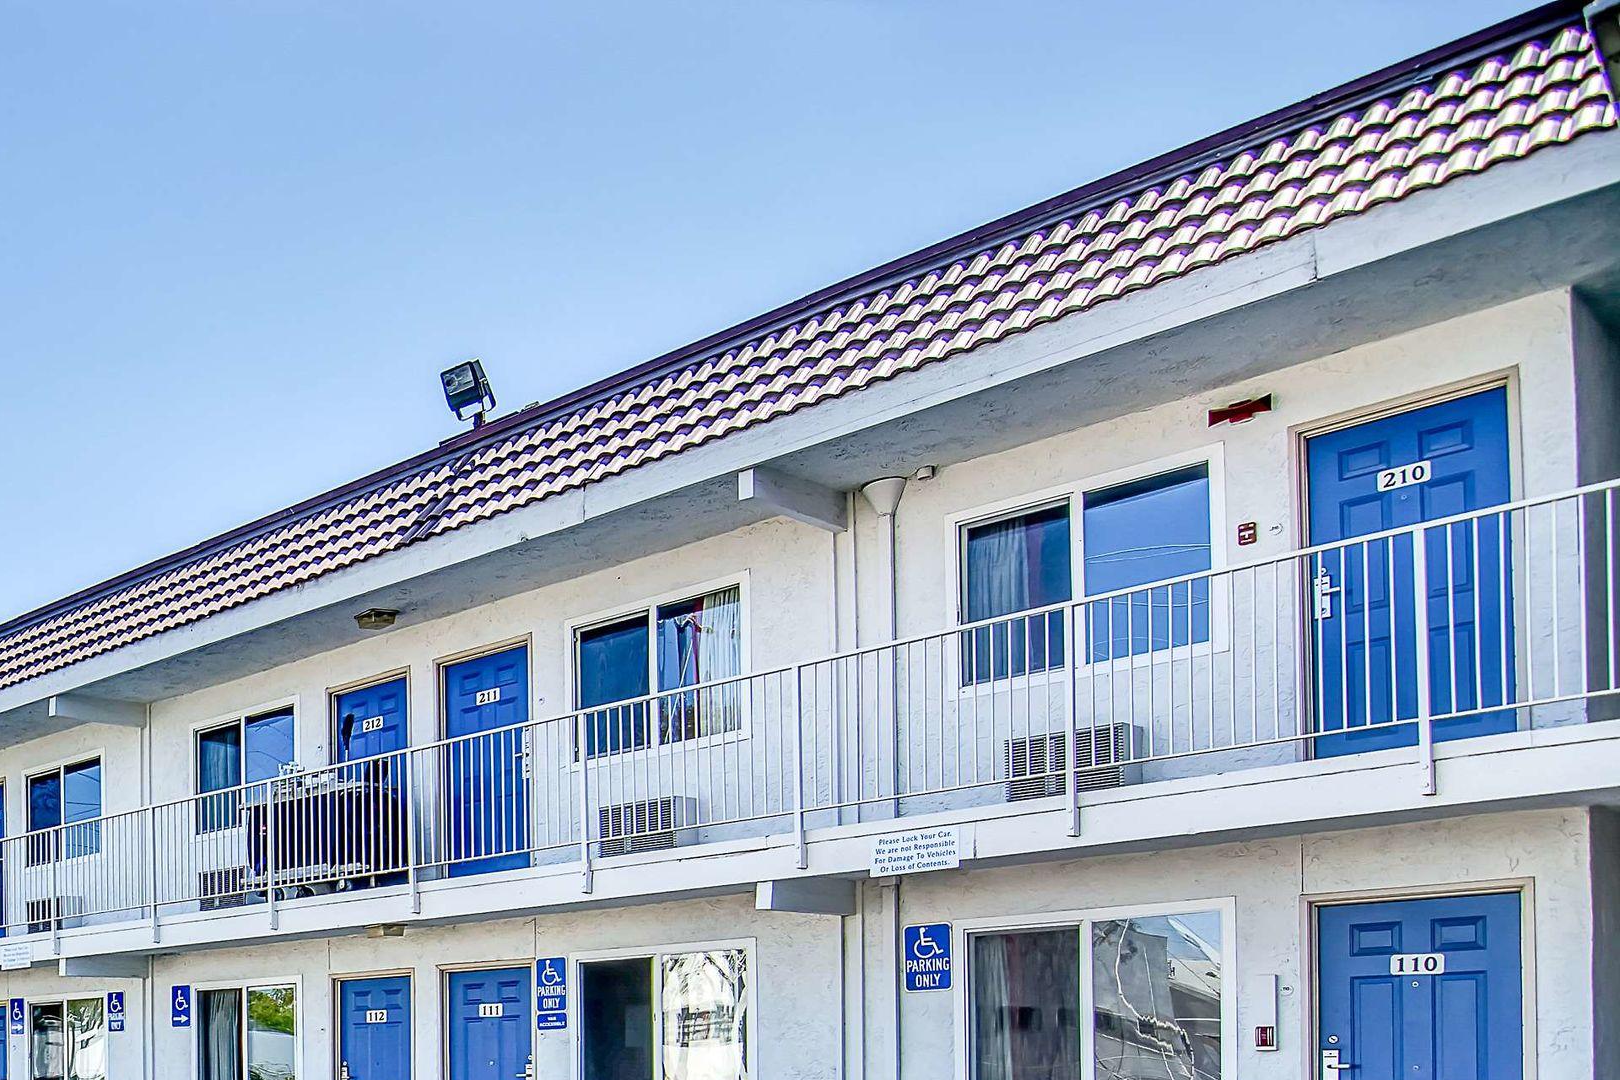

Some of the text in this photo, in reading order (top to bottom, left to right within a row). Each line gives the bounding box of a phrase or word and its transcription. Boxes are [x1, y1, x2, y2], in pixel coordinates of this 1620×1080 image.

[1383, 465, 1425, 488] 210
[479, 691, 498, 704] 211
[365, 717, 382, 730] 212
[878, 838, 900, 846] Please
[902, 835, 918, 843] Lock
[920, 833, 936, 841] Your
[913, 840, 956, 851] Responsible
[874, 849, 956, 865] For Damage To Vehicles
[906, 957, 950, 973] PARKING
[1397, 956, 1437, 973] 110
[915, 973, 941, 988] ONLY
[537, 985, 566, 997] PARKING
[542, 998, 560, 1009] ONLY
[368, 1012, 385, 1022] 112
[482, 1005, 499, 1016] 111
